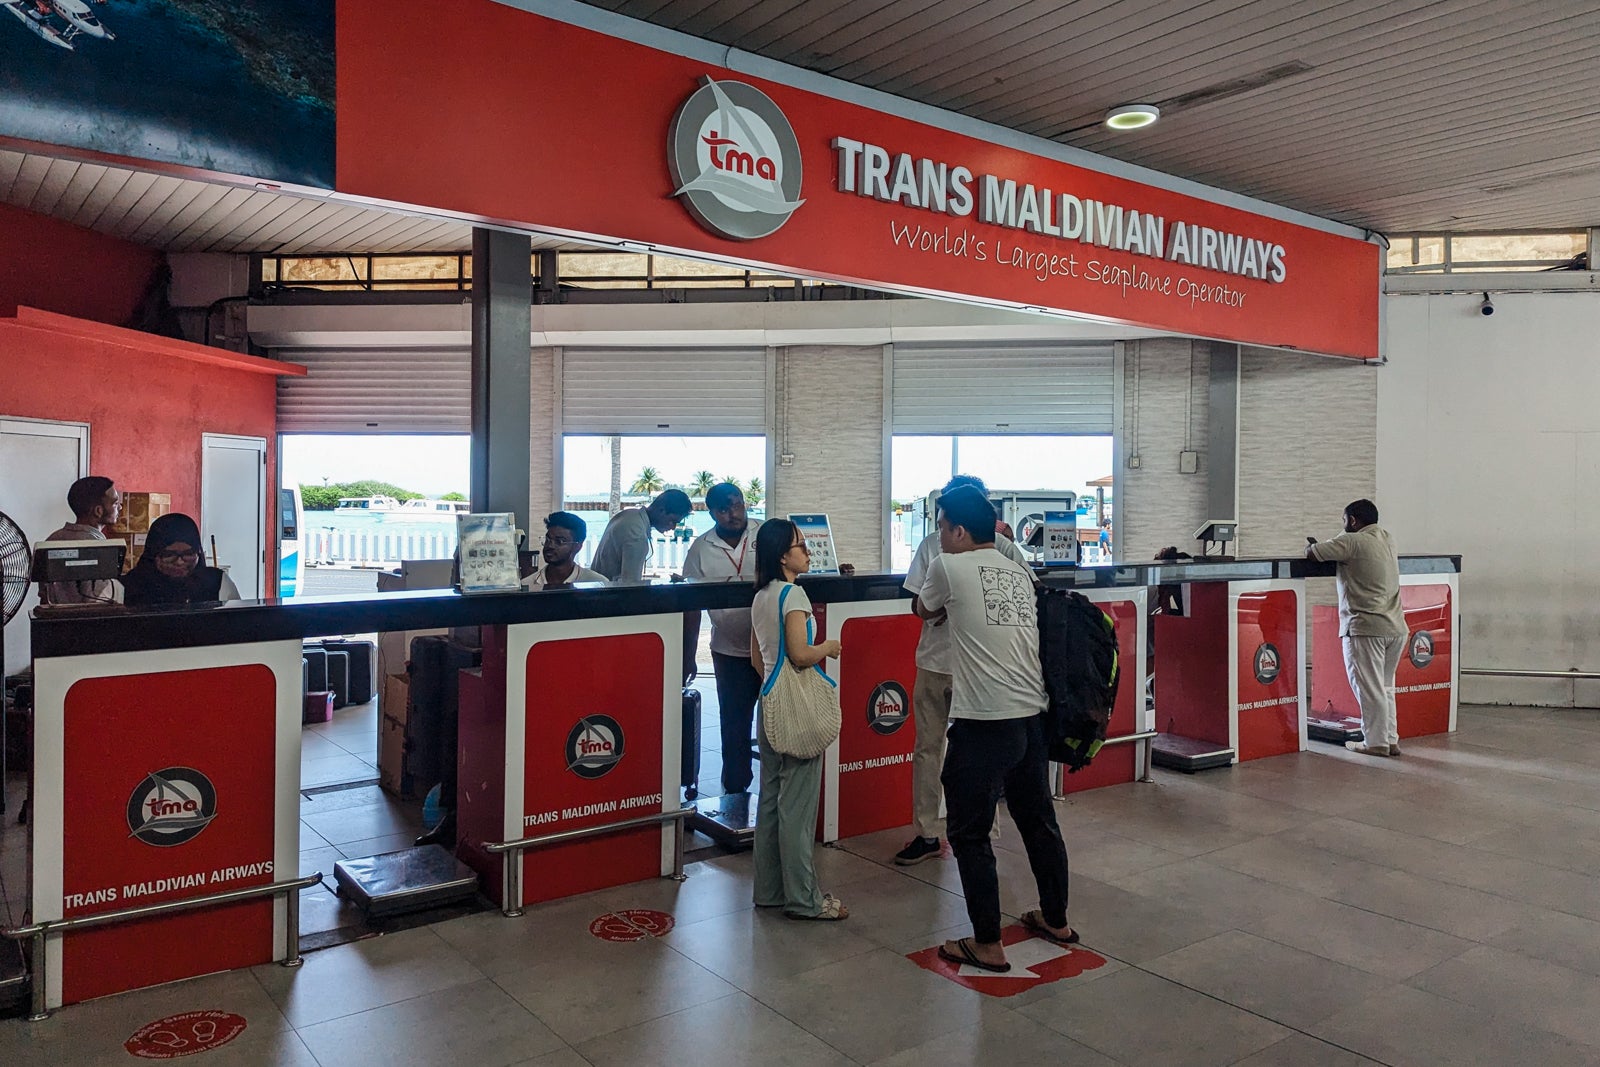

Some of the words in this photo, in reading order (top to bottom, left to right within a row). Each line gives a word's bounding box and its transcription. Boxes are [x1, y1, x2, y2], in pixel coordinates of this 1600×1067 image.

[701, 130, 776, 181] tma
[832, 136, 974, 216] TRANS
[979, 174, 1164, 258] MALDIVIAN
[1166, 220, 1287, 285] AIRWAYS
[890, 220, 988, 262] World's
[996, 242, 1079, 282] Largest
[1083, 260, 1171, 297] Seaplane
[1176, 277, 1247, 308] Operator
[1409, 683, 1433, 692] MALDIVIAN
[877, 701, 900, 714] tma
[1236, 702, 1253, 711] TRANS
[1253, 698, 1278, 709] MALDIVIAN
[1278, 696, 1299, 705] AIRWAYS
[578, 739, 612, 754] tma
[838, 761, 863, 773] TRANS
[865, 754, 904, 769] MALDIVIAN
[145, 798, 198, 816] tma
[523, 811, 558, 827] TRANS
[562, 800, 617, 820] MALDIVIAN
[619, 793, 662, 810] AIRWAYS
[64, 887, 117, 909] TRANS
[123, 873, 206, 899] MALDIVIAN
[210, 860, 274, 884] AIRWAYS
